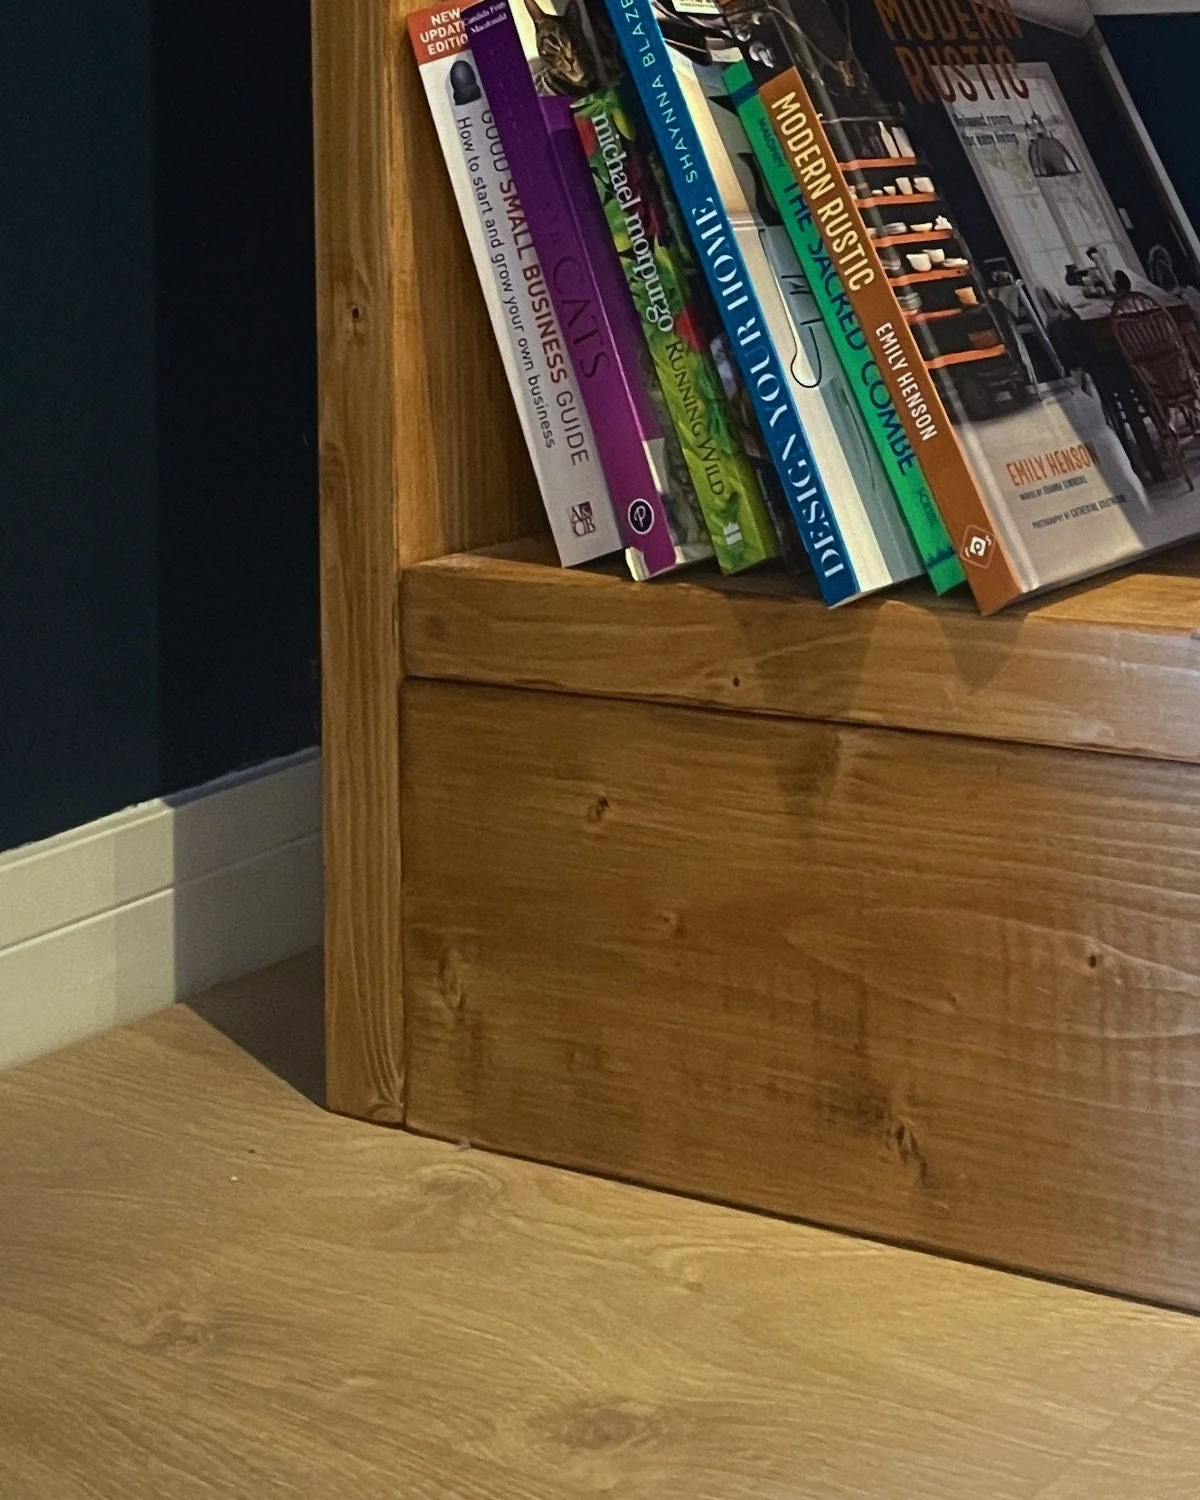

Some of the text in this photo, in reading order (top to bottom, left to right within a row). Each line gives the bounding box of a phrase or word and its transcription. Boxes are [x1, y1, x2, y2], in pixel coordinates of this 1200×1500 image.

[419, 19, 466, 44] UPDAT
[427, 33, 469, 56] EDITIO
[430, 7, 461, 27] NEW
[893, 43, 1030, 105] RUSTIC
[651, 74, 698, 183] SHAYNNA
[591, 111, 674, 332] michael morpurgo
[771, 91, 938, 442] MODERN RUSTIC EMILY HENSON
[457, 117, 556, 449] How to start and grow your own business
[500, 179, 537, 260] SMALL
[522, 264, 568, 384] BUSINESS
[556, 389, 590, 466] GUIDE
[553, 257, 610, 379] CATS
[665, 340, 725, 496] RUNNING WILD
[691, 197, 845, 578] DESIGN YOUR HOME
[1006, 455, 1048, 487] EMILY
